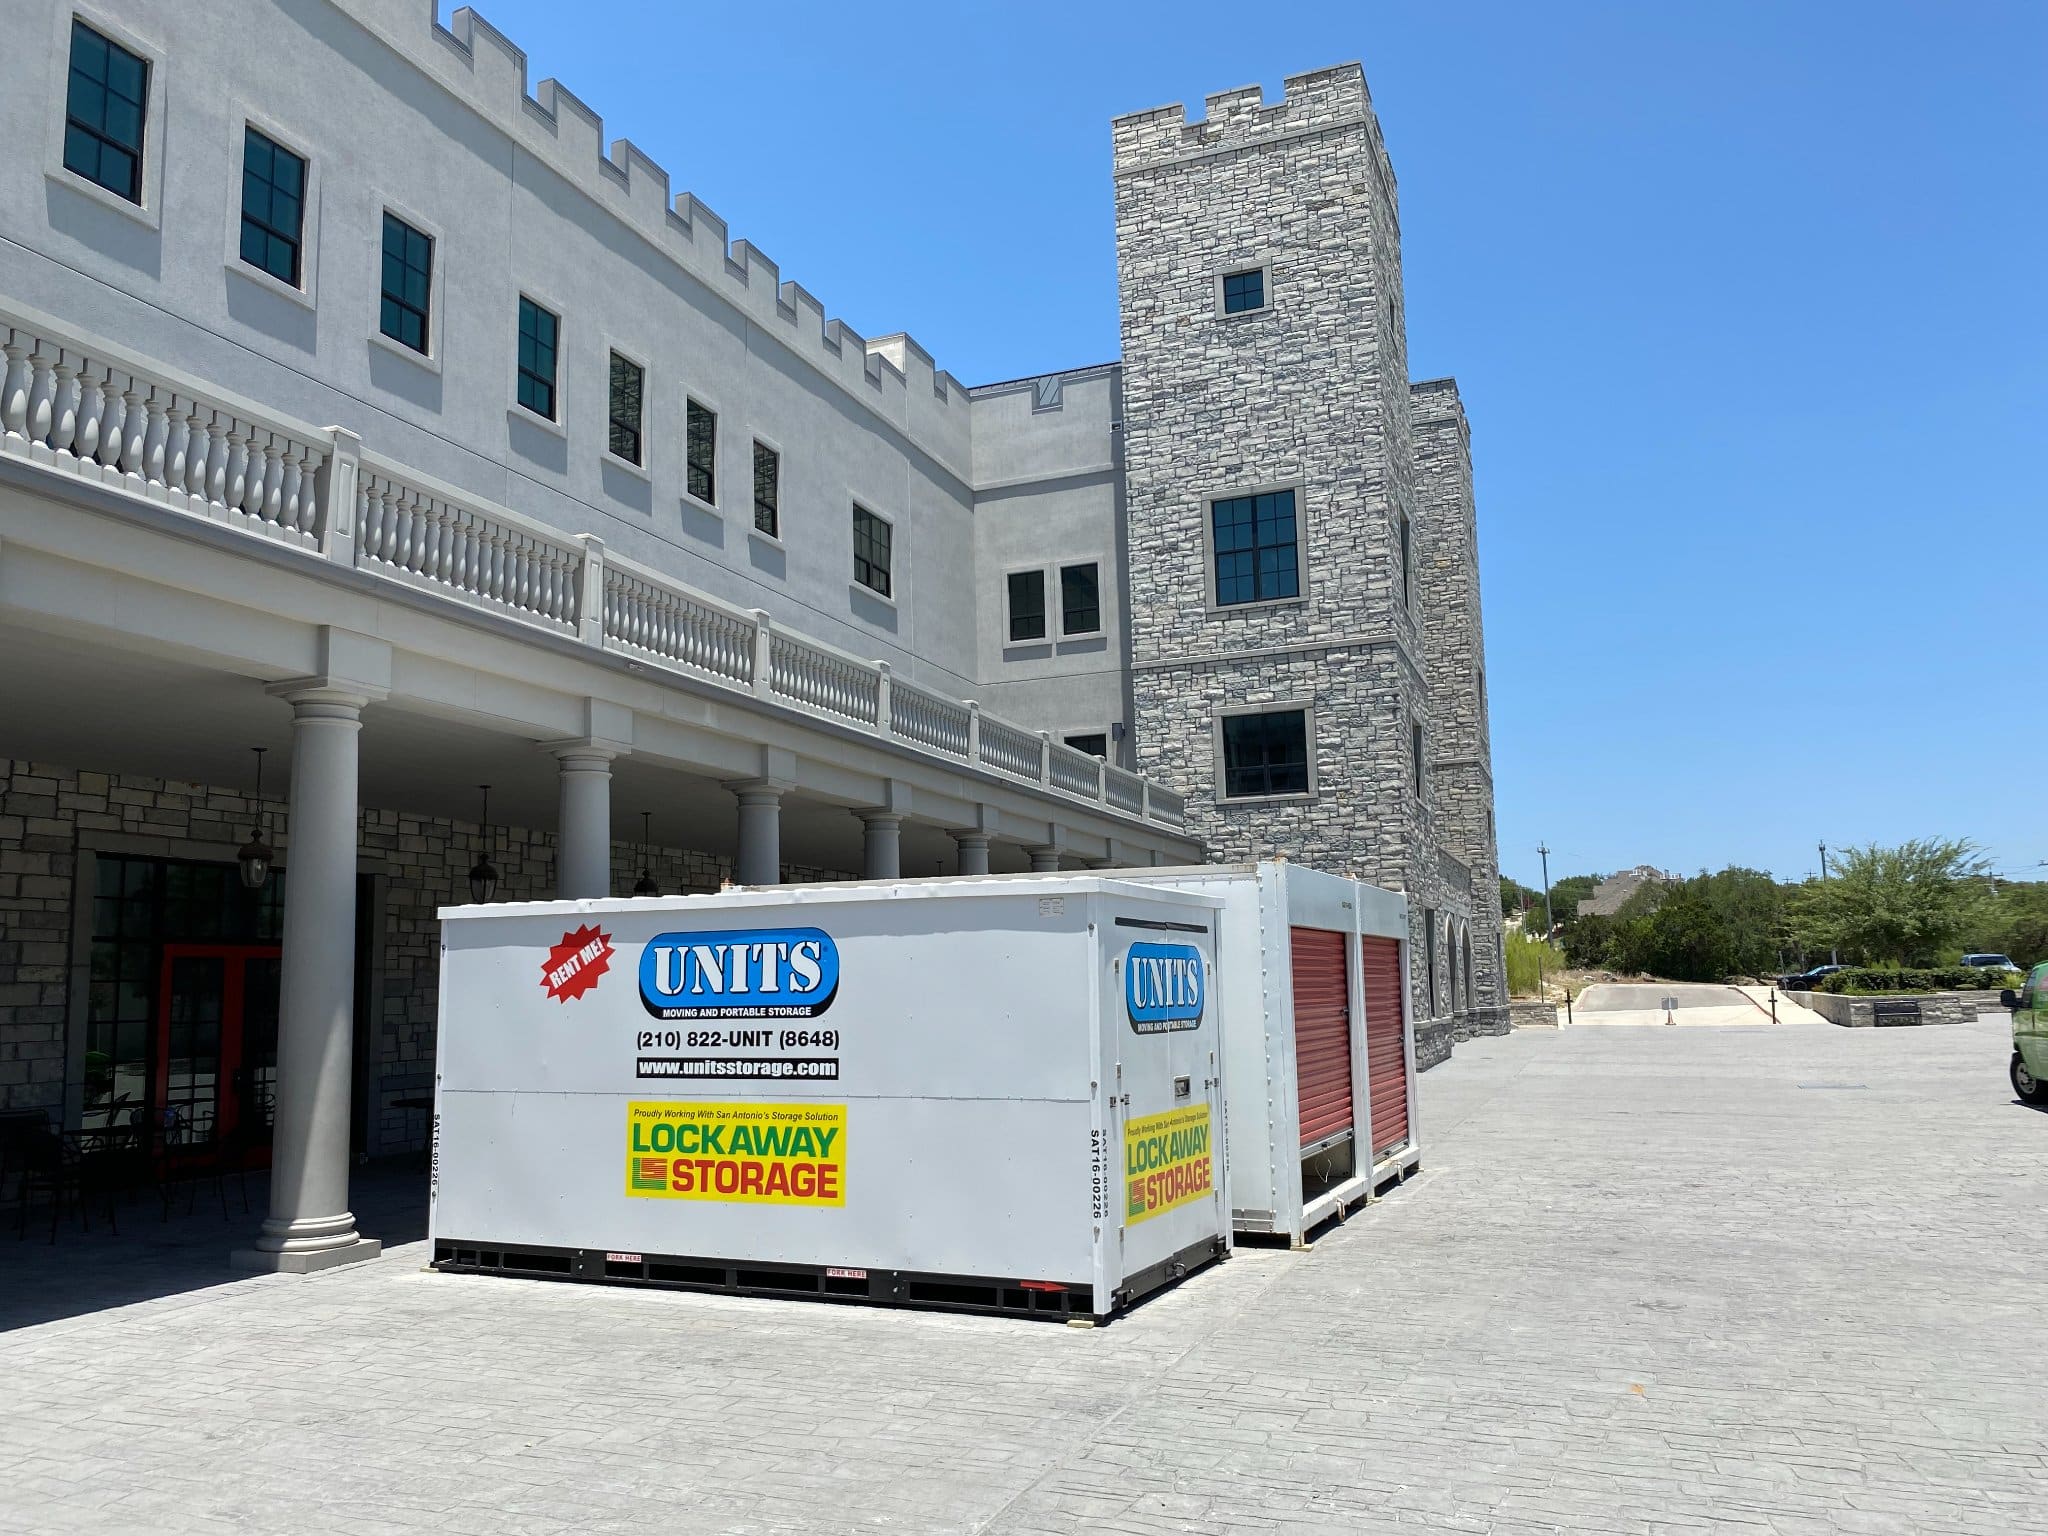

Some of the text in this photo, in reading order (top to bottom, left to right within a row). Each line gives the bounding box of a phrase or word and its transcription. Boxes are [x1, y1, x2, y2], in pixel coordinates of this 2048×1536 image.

[549, 936, 605, 989] RENT ME!
[654, 941, 822, 995] UNITS
[1131, 957, 1198, 1008] UNITS
[663, 1006, 812, 1018] MOVING AND PORTABLE STORAGE
[637, 1030, 839, 1050] (210) 822-UNIT (8648)
[639, 1060, 836, 1077] www.unitsstorage.com
[632, 1122, 839, 1158] LOCKAWAY
[634, 1108, 839, 1122] Proudly Working With San Antonio's Storage Solution
[432, 1114, 440, 1186] SAT16-00226
[1091, 1129, 1101, 1219] SAT16-00226
[1127, 1124, 1208, 1175] LOCKAWAY
[672, 1158, 838, 1199] STORAGE
[1147, 1157, 1211, 1210] STORAGE
